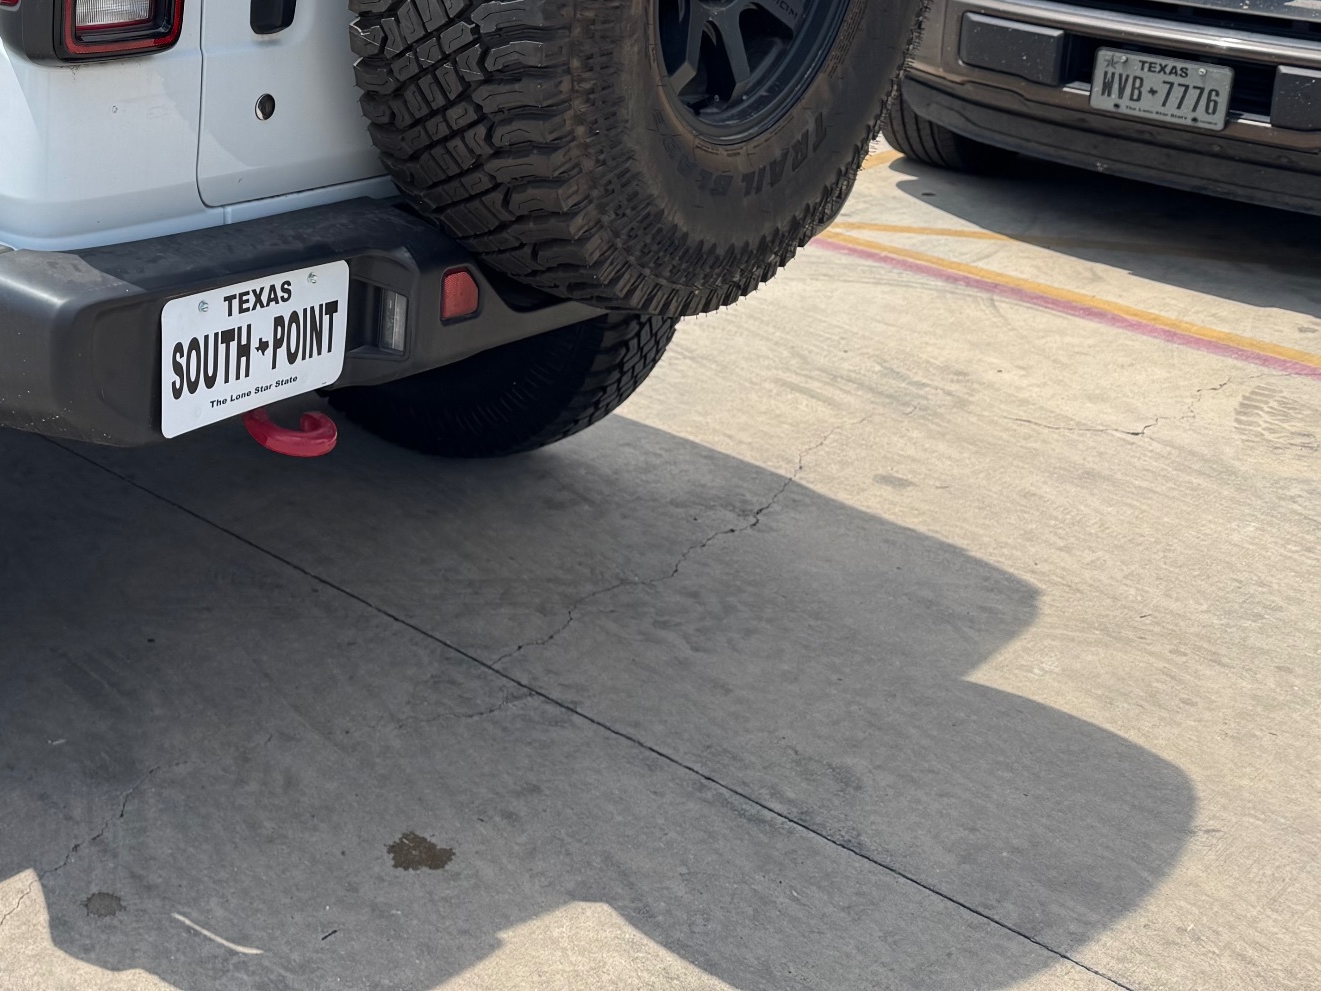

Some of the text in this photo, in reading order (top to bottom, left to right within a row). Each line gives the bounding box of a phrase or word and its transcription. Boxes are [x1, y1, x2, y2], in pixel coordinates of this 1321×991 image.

[1139, 59, 1189, 78] TEXAS
[1101, 70, 1220, 116] WVB 7776
[223, 280, 292, 317] TEXAS
[171, 300, 339, 400] SOUTH POINT
[210, 375, 298, 408] The Lone Star State
